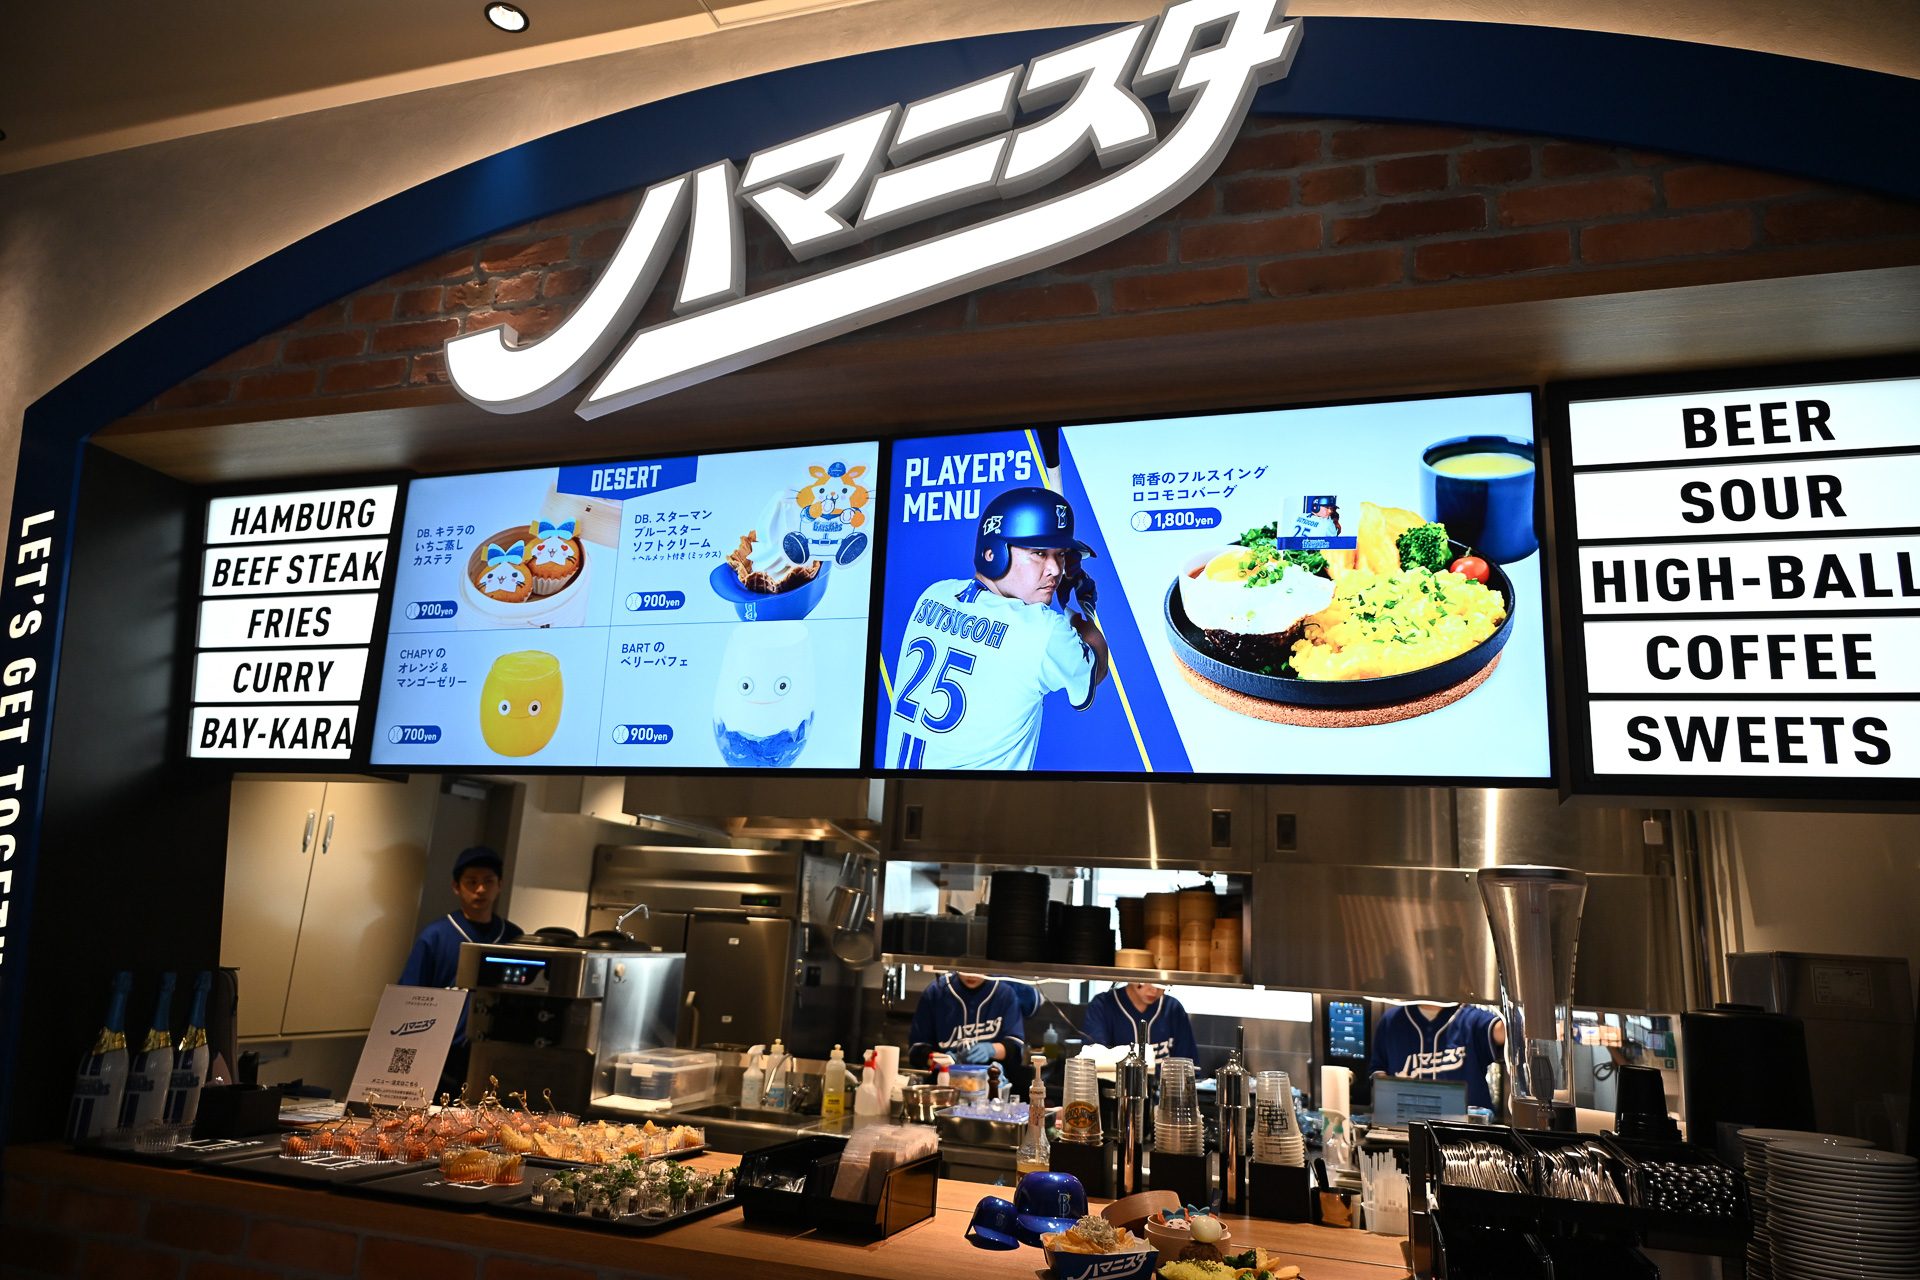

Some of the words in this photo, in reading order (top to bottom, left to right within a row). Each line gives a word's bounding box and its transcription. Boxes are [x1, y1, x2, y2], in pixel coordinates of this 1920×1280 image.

[446, 0, 1302, 420] ハマニスタ
[1682, 399, 1836, 449] BEER
[591, 464, 662, 492] DESERT
[904, 450, 1033, 488] PLAYER'S
[1132, 465, 1269, 488] 筒香のフルスイング
[902, 489, 981, 523] MENU
[1133, 484, 1238, 502] ロコモコバーグ
[1680, 474, 1847, 524] SOUR
[230, 498, 376, 536] HAMBURG
[417, 529, 432, 538] DB.
[435, 525, 475, 536] キララの
[634, 514, 652, 524] DB.
[656, 510, 712, 523] スターマン
[634, 524, 701, 538] ブルースター
[413, 554, 453, 566] カステラ
[415, 539, 464, 552] いちご蒸し
[633, 538, 711, 552] ソフトクリーム
[8, 510, 55, 639] LET'S
[212, 555, 287, 587] BEEF
[286, 550, 384, 584] STEAK
[1592, 551, 1920, 603] HIGH-BALL
[247, 606, 332, 639] FRIES
[400, 648, 434, 659] CHAPY
[436, 647, 446, 658] の
[620, 655, 688, 668] ベリーパフェ
[621, 642, 651, 653] BART
[653, 641, 665, 653] の
[1646, 633, 1877, 680] COFFEE
[233, 661, 335, 693] CURRY
[396, 676, 467, 688] マンゴーゼリー
[398, 661, 438, 673] オレンジ
[441, 662, 448, 672] &
[0, 657, 38, 744] GET
[894, 635, 977, 734] 25
[200, 717, 352, 750] BAY-KARA
[1626, 715, 1892, 765] SWEETS
[390, 1018, 437, 1037] ハマニスタ
[1395, 1046, 1467, 1079] ハマニスタ
[1066, 1252, 1149, 1280] ハマニスタ
